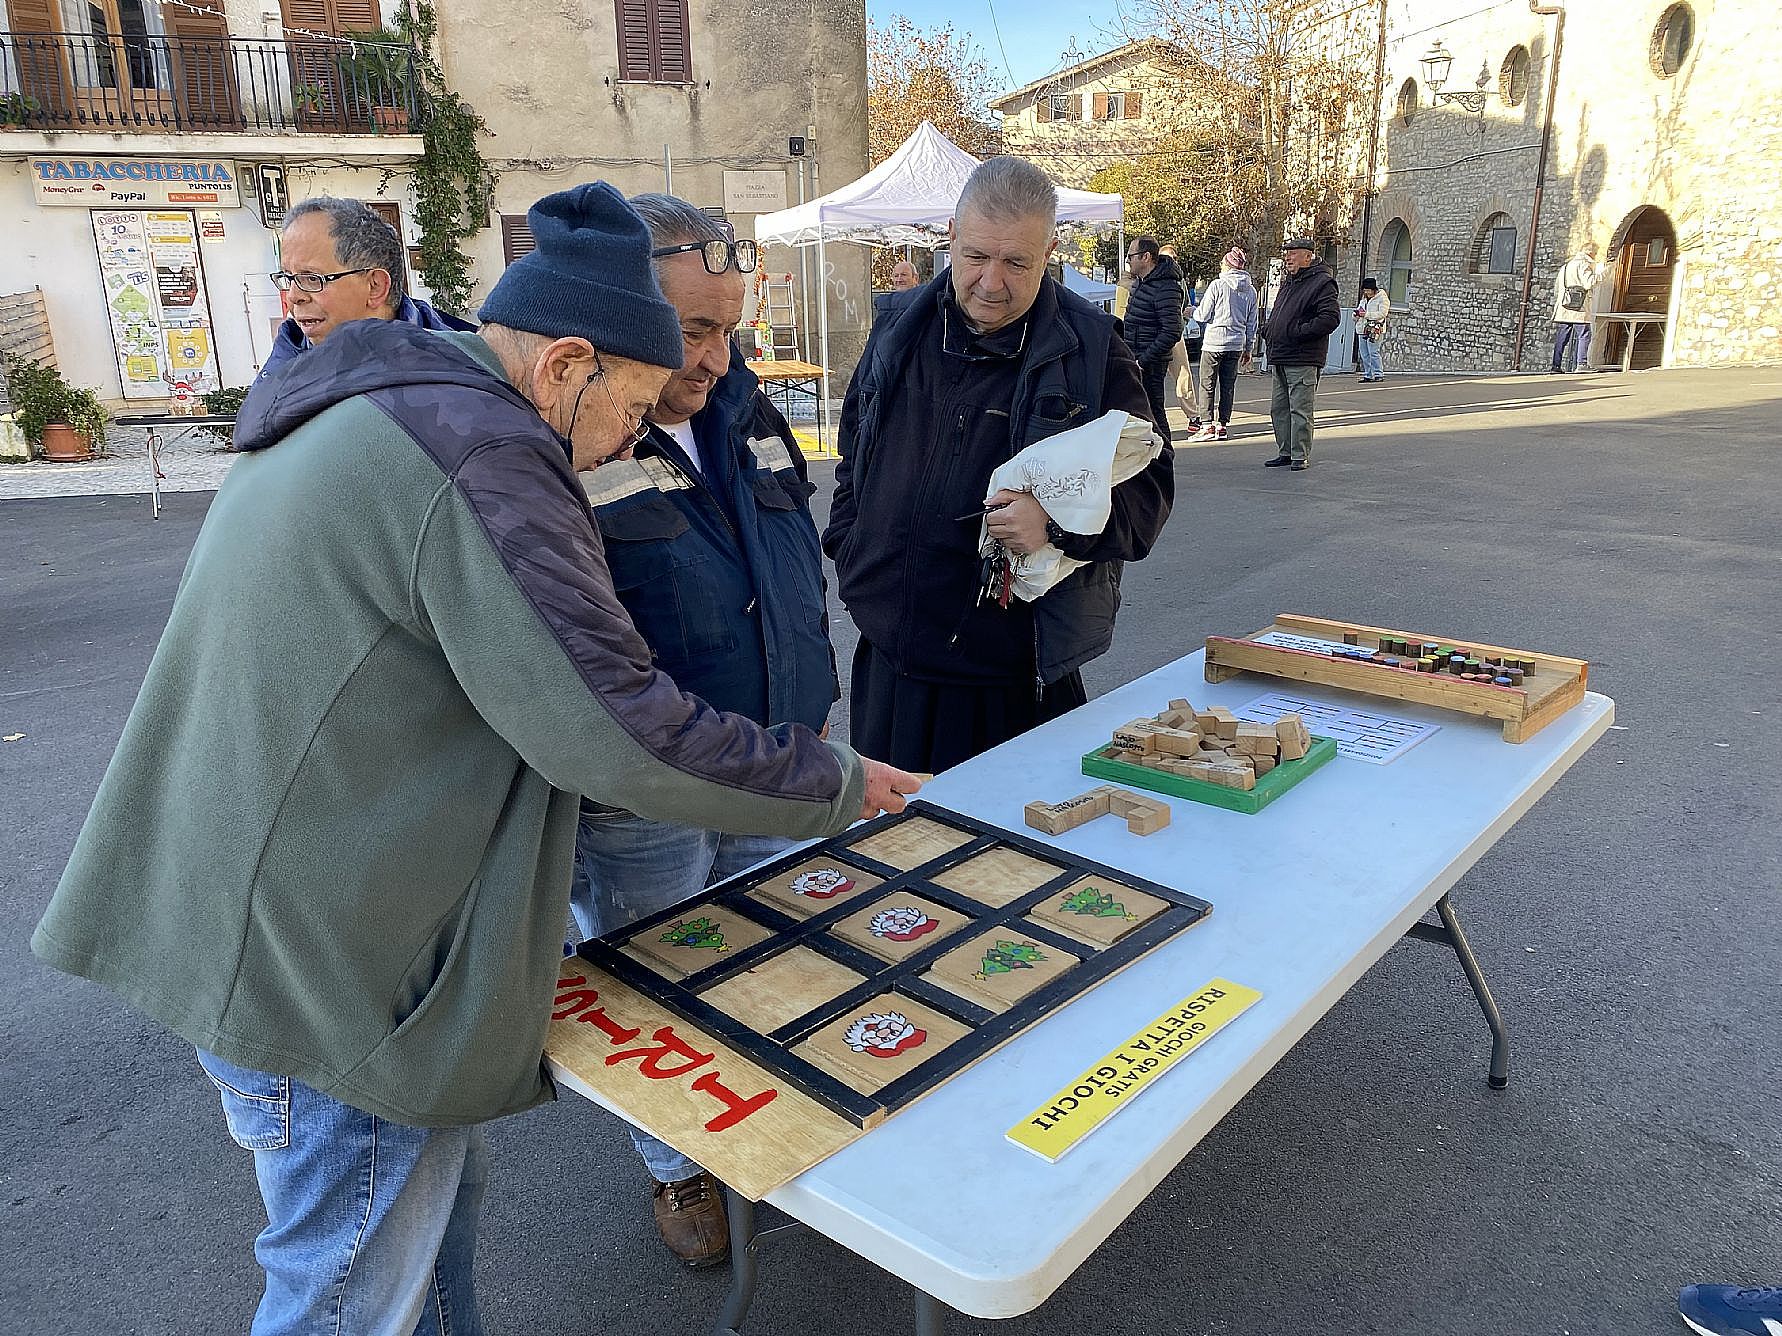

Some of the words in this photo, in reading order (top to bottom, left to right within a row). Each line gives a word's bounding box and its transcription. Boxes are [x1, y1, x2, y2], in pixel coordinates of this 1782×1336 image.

[33, 161, 233, 182] TABACCHERIA
[111, 192, 146, 202] PayPal
[111, 225, 126, 233] 10
[1130, 987, 1227, 1051] RISPETTA
[1158, 1022, 1207, 1058] GIOCHI
[1115, 1053, 1135, 1065] I
[1104, 1057, 1159, 1098] GRATIS
[1031, 1065, 1118, 1131] GIOCHI
